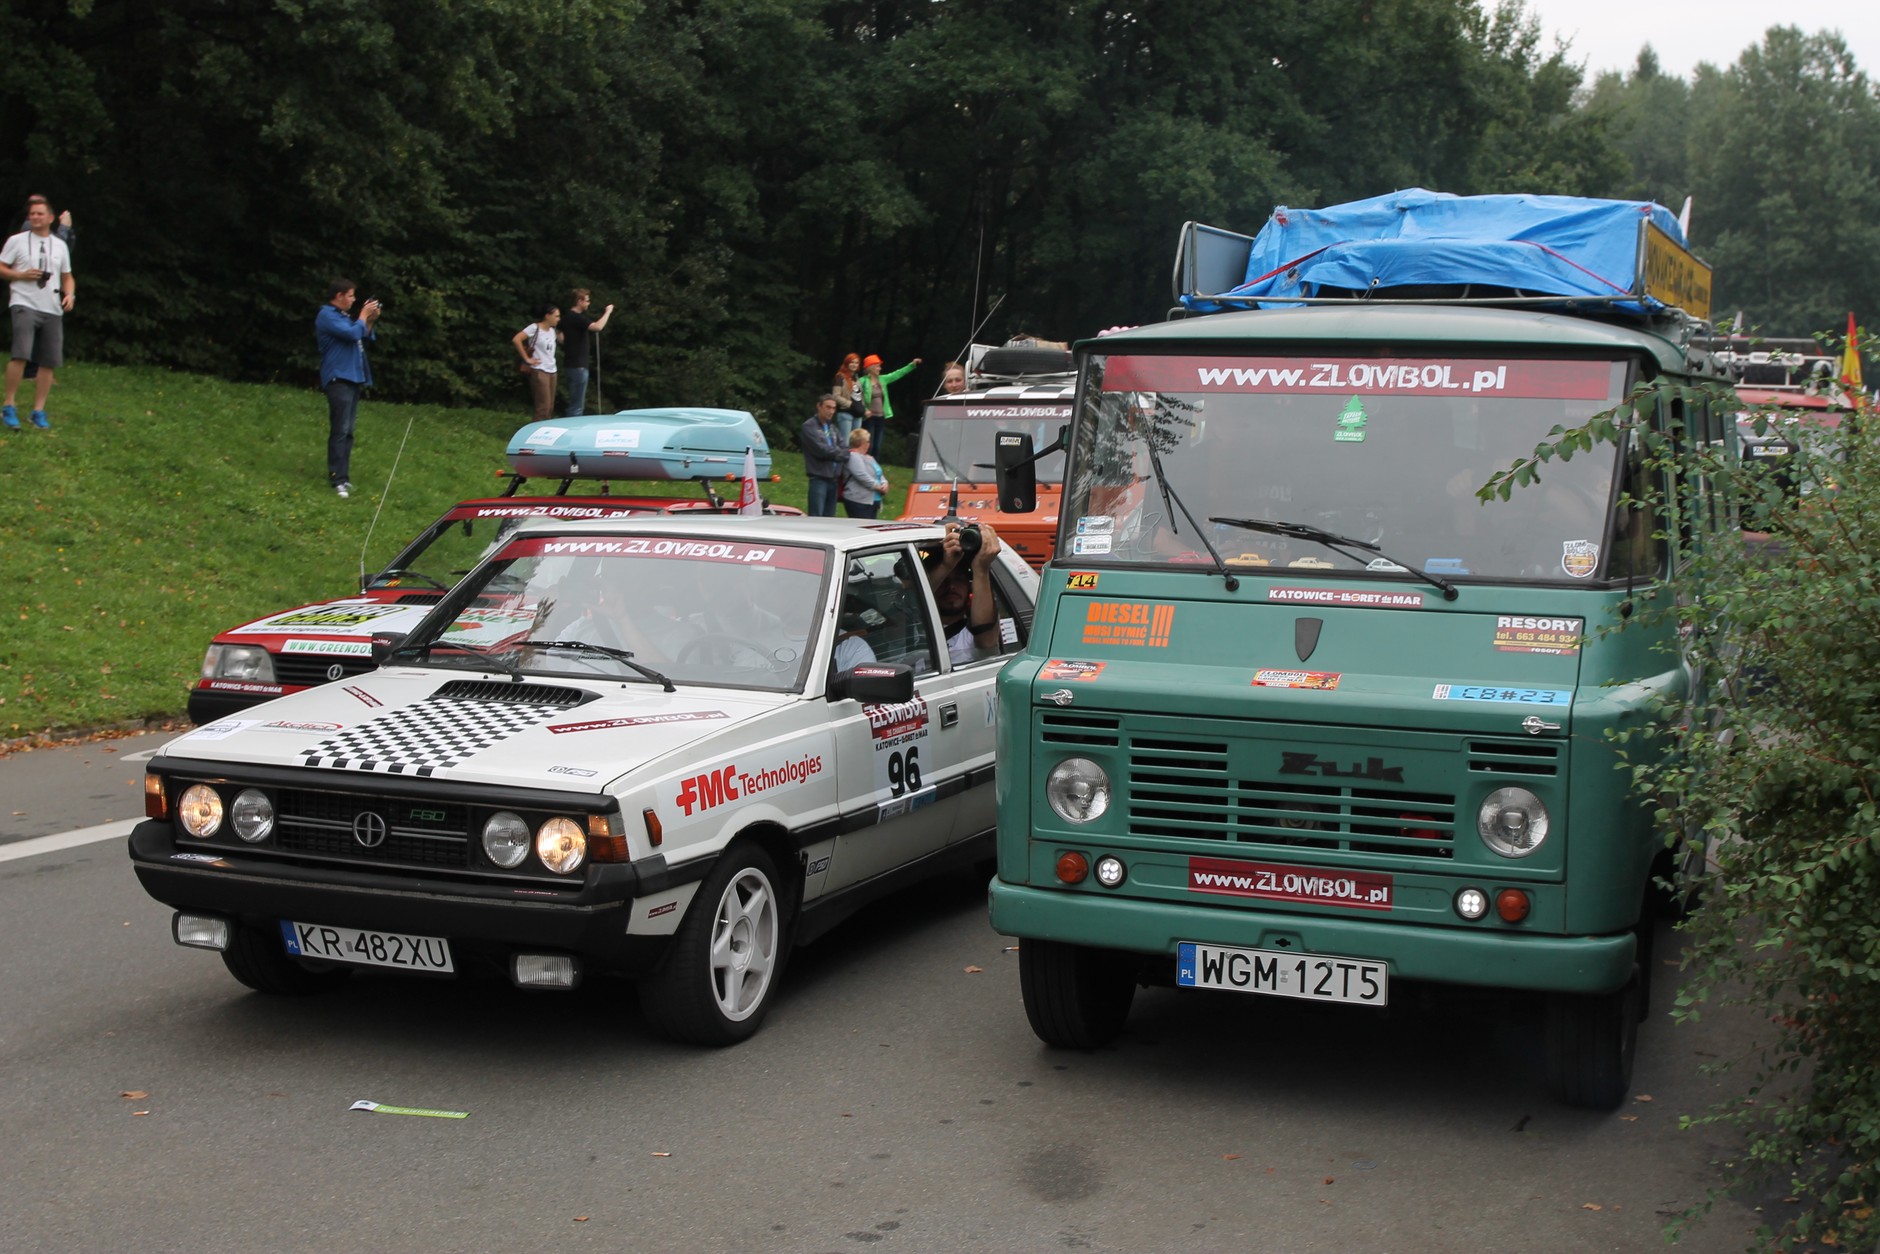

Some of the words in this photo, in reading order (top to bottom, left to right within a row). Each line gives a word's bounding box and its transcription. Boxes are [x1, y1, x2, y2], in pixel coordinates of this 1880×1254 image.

[1087, 602, 1150, 625] DIESEL
[1497, 616, 1579, 632] RESORY
[1496, 632, 1512, 640] tel.
[1516, 632, 1534, 641] 663
[1537, 633, 1556, 642] 484
[1531, 647, 1561, 655] resory
[676, 765, 739, 816] FMC
[738, 754, 822, 796] Technologies
[888, 746, 922, 799] 96
[298, 924, 344, 957] KR
[354, 932, 448, 968] 482XU
[1181, 969, 1193, 979] PL
[1203, 949, 1277, 990] WGM
[1294, 960, 1379, 1000] 12T5
